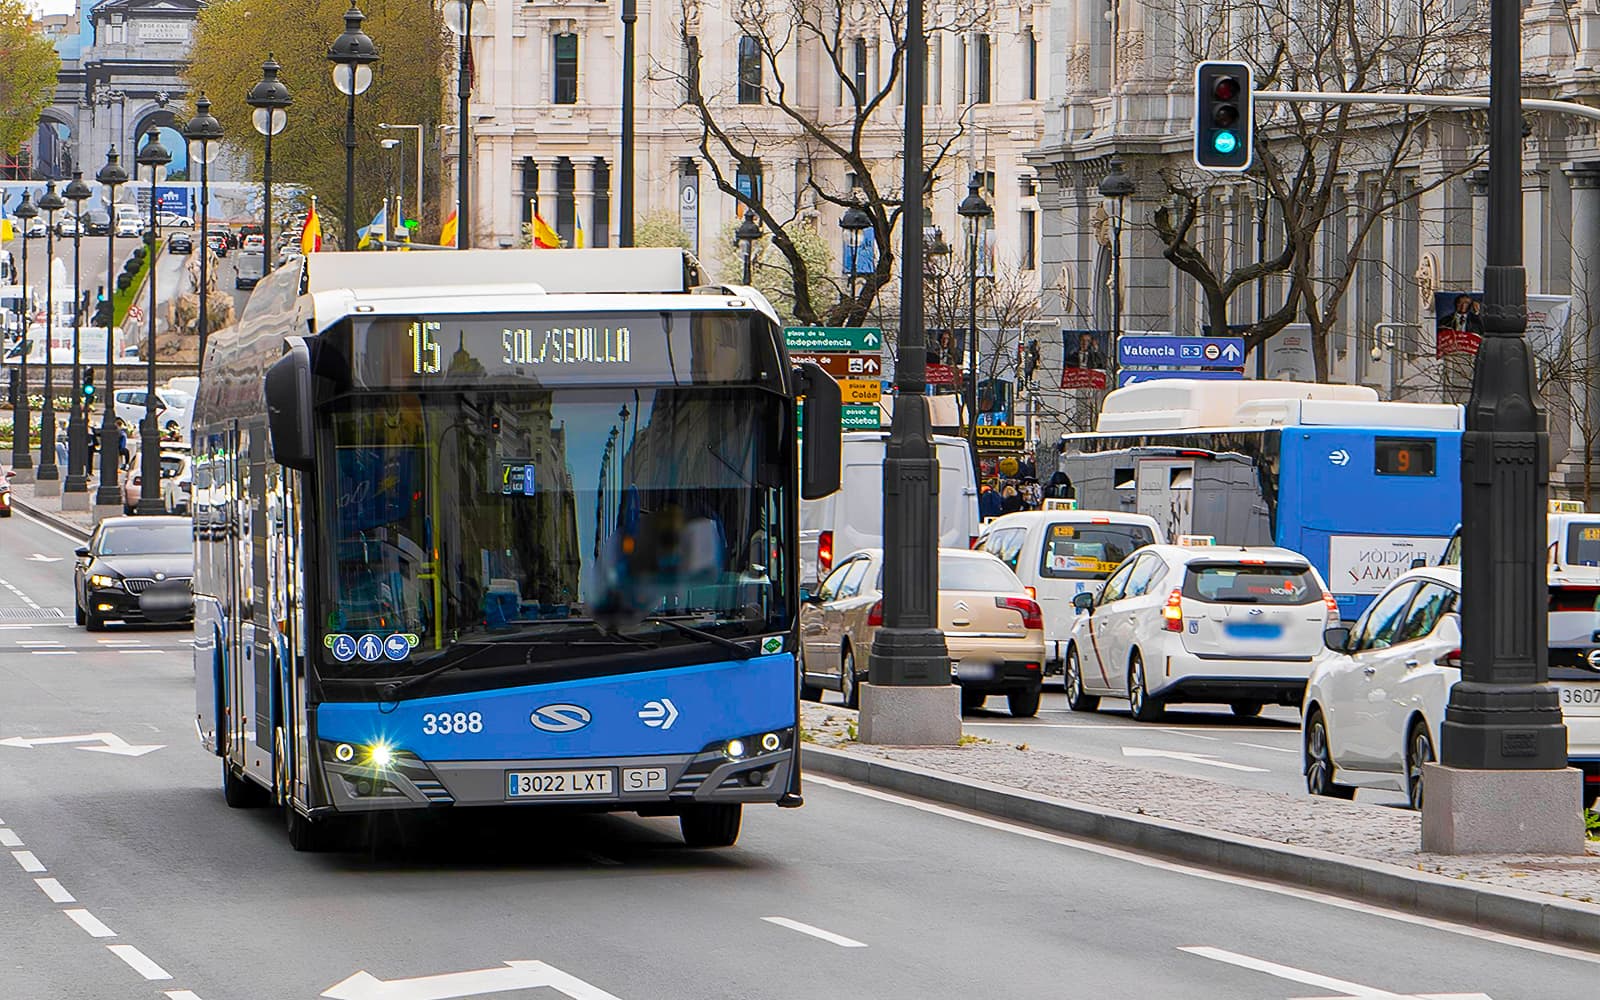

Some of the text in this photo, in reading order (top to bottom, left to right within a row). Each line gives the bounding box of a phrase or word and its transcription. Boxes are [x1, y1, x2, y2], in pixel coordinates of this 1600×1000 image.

[408, 321, 632, 373] 15 SOL/SEVILLA
[786, 338, 851, 347] Independencia
[1123, 345, 1200, 356] Valencia R-3
[841, 417, 878, 425] ecoletos
[977, 427, 1023, 437] UVENIRS
[1397, 449, 1410, 471] 9
[1563, 689, 1600, 703] 3607
[423, 712, 483, 735] 3388
[521, 774, 606, 792] 3022 LXT
[630, 771, 660, 789] SP
